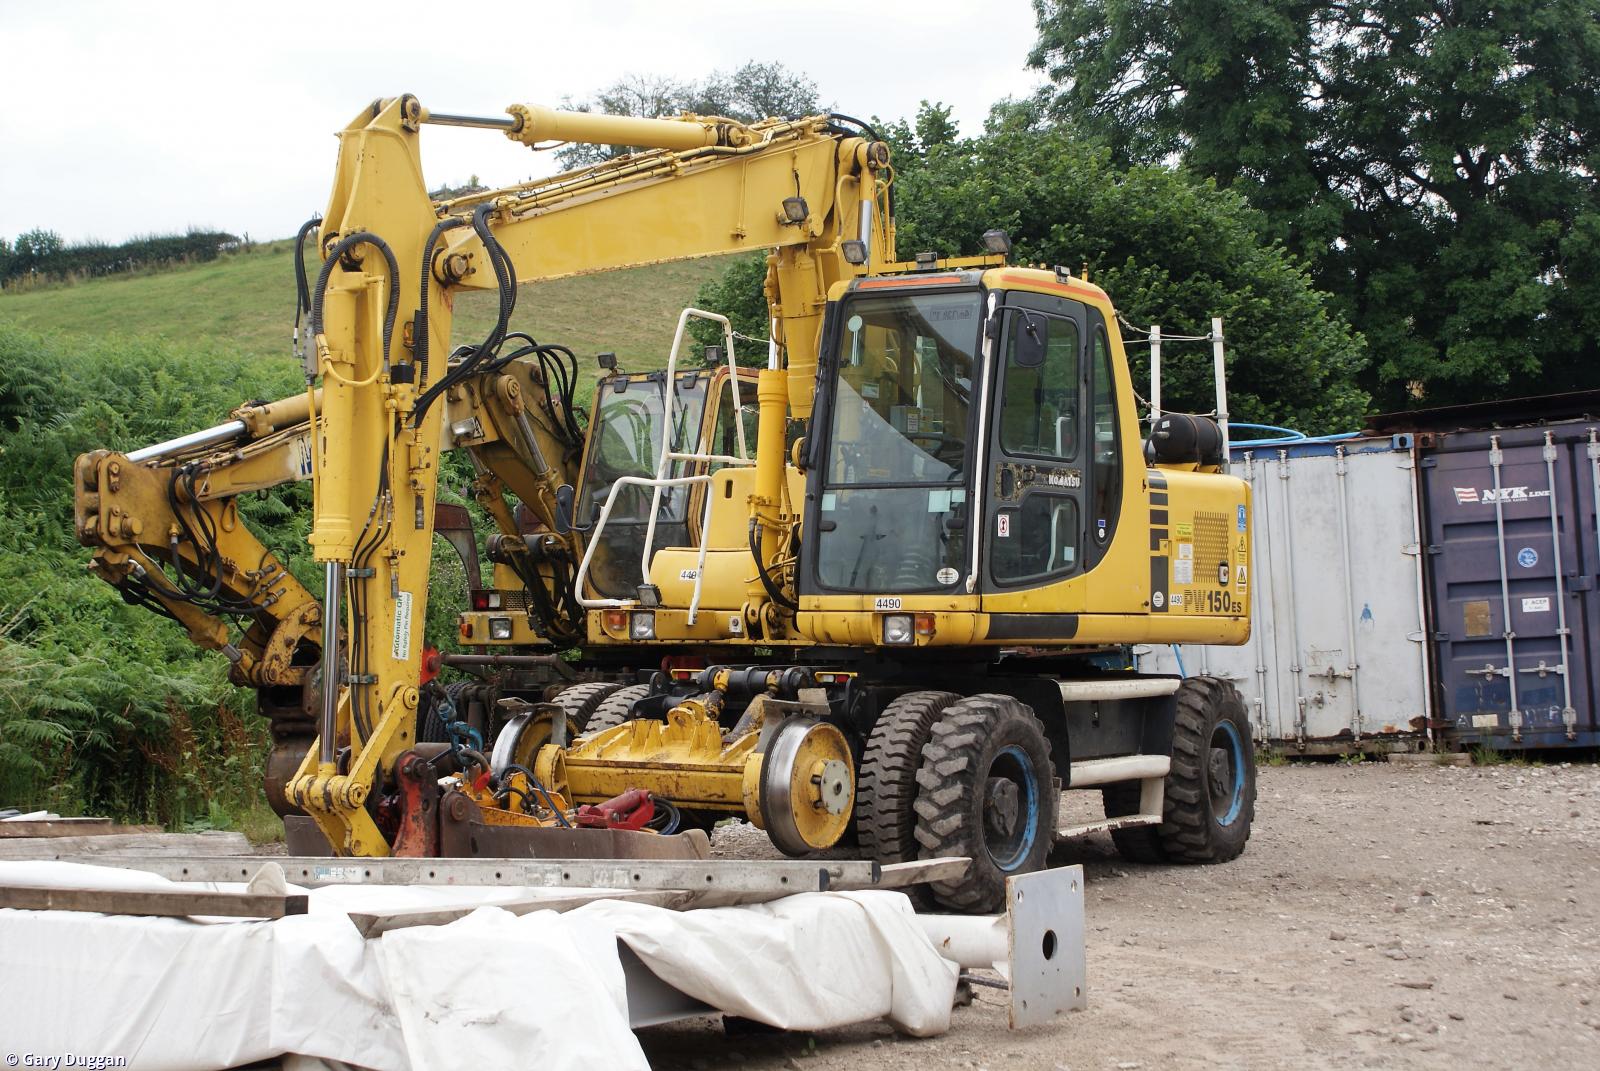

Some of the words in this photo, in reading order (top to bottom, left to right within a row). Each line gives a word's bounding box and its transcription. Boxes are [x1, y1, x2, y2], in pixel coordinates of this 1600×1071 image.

[1048, 474, 1081, 488] KOMATSU
[1482, 486, 1528, 501] NYK
[876, 598, 901, 609] 4490
[394, 610, 402, 657] Automatic
